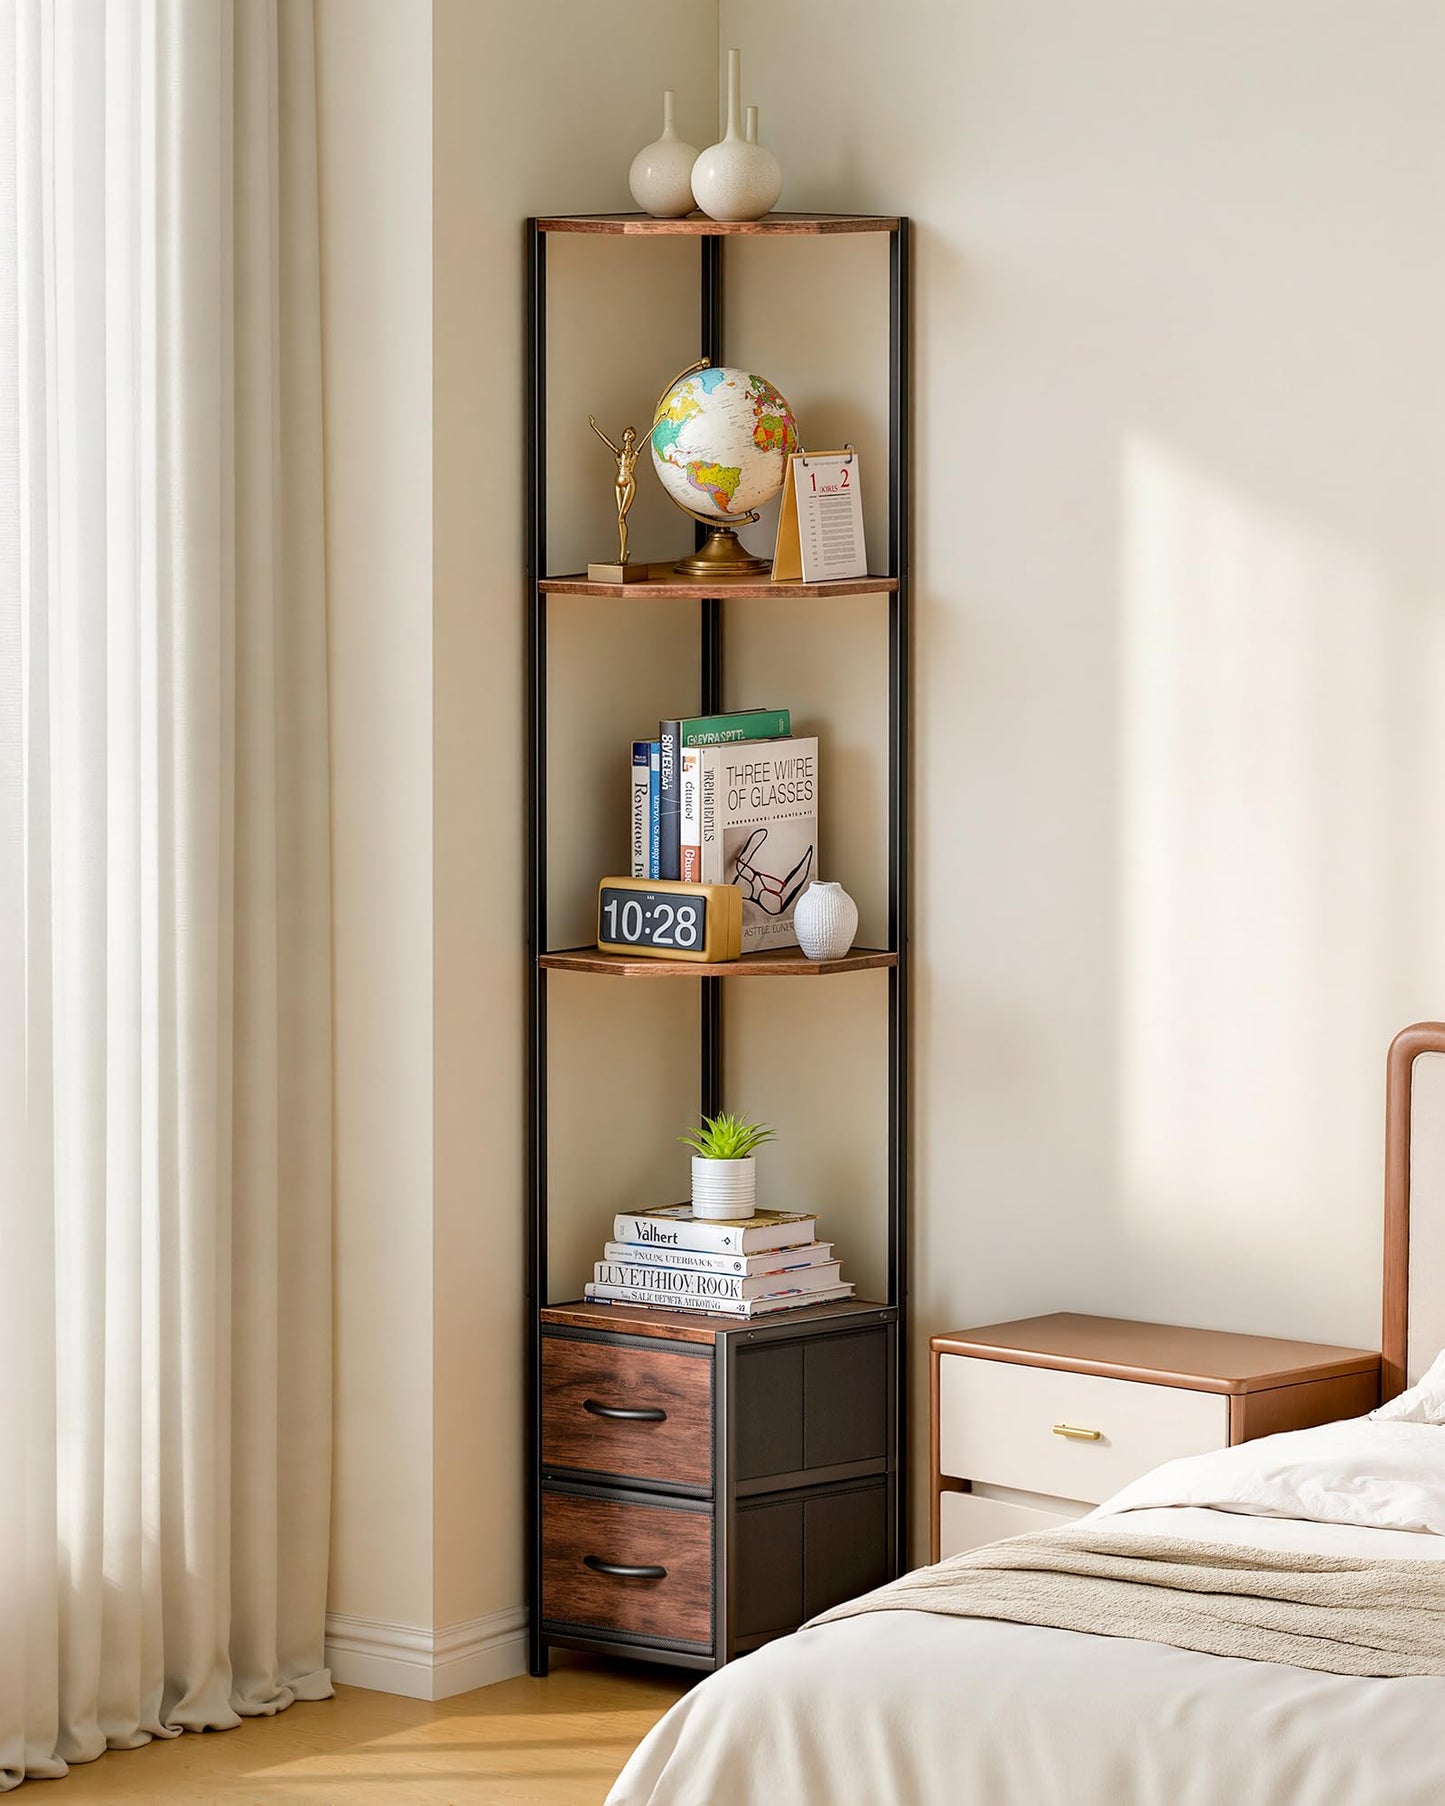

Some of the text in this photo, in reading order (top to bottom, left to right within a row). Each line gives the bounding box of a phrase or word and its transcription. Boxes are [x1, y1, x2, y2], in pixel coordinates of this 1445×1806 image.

[810, 472, 816, 492] 1
[840, 468, 850, 488] 2
[726, 761, 771, 787] THREE
[727, 780, 814, 811] OF GLASSES
[604, 899, 698, 947] 10:28
